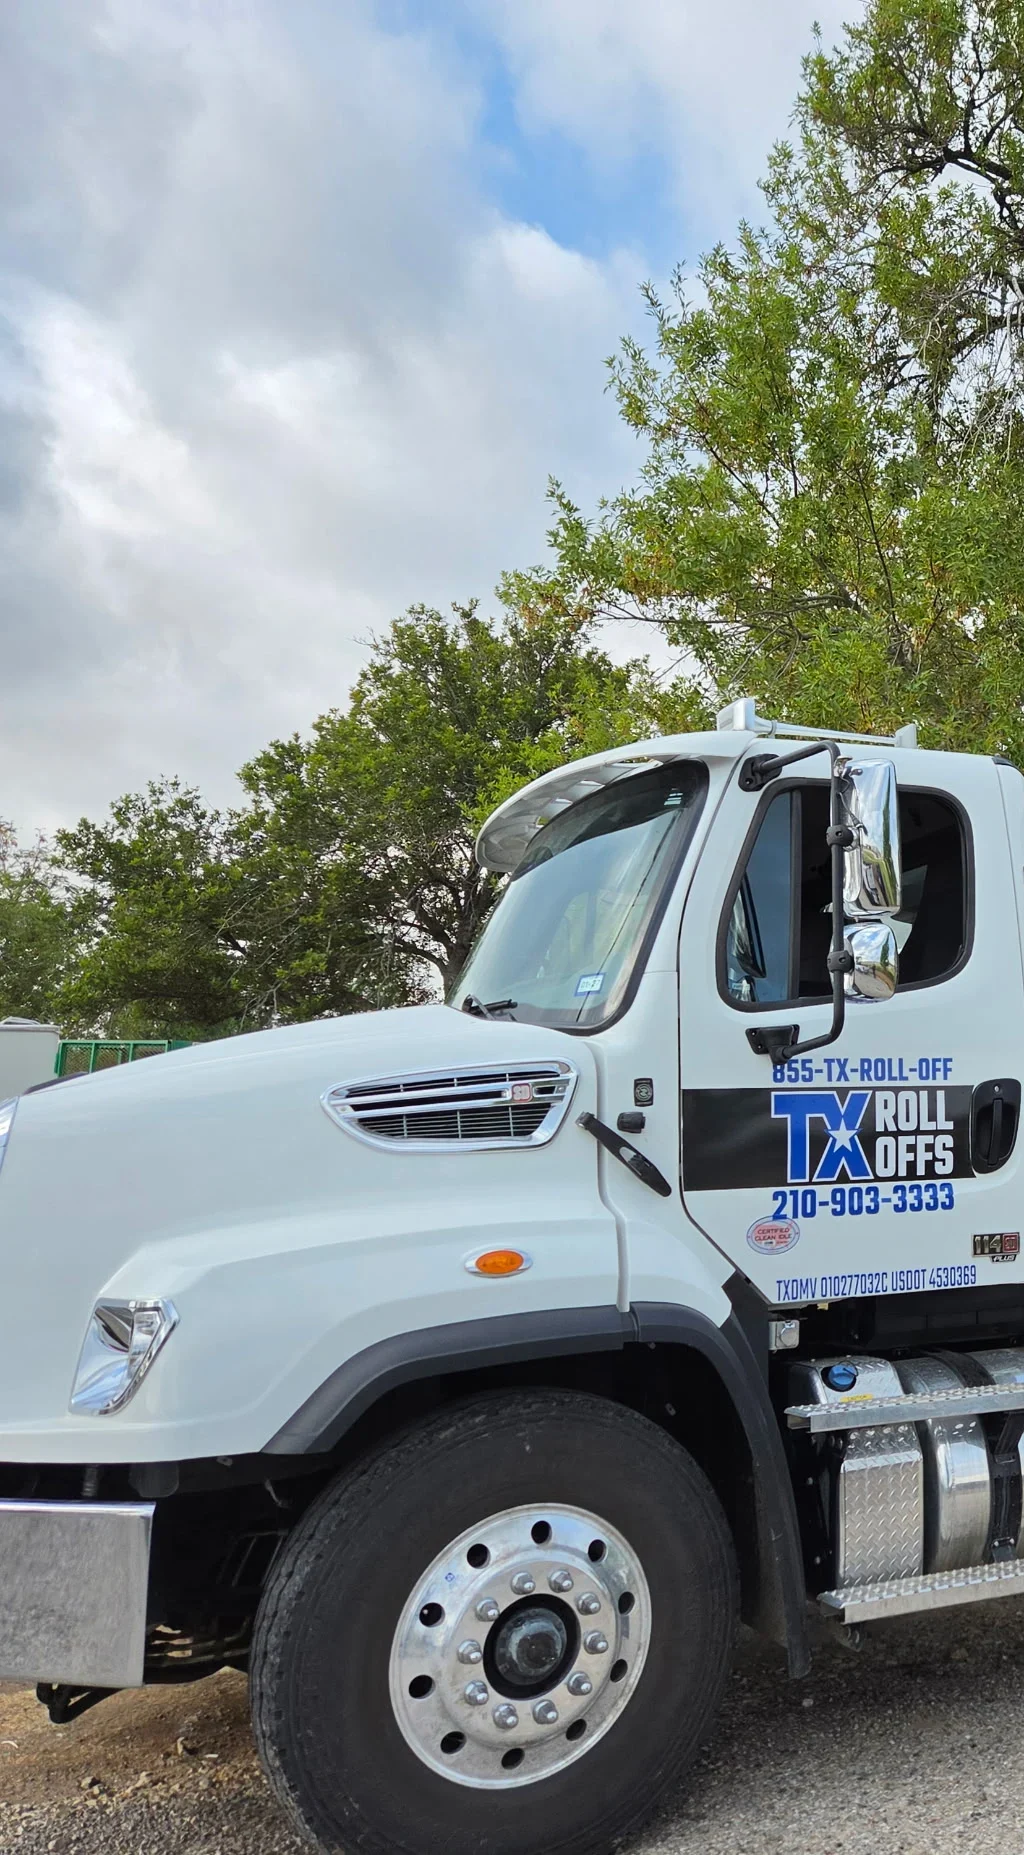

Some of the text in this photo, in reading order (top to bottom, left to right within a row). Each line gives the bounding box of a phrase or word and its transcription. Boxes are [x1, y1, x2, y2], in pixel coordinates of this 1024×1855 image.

[772, 1058, 953, 1084] 855-TX-ROLL-OFF
[875, 1090, 954, 1131] ROLL
[771, 1090, 874, 1183] TX
[875, 1135, 954, 1177] OFFS
[772, 1183, 955, 1221] 210-903-3333
[757, 1227, 790, 1235] CERTIFIED
[776, 1265, 976, 1301] TXDMV 010277032C USDOT 4530369
